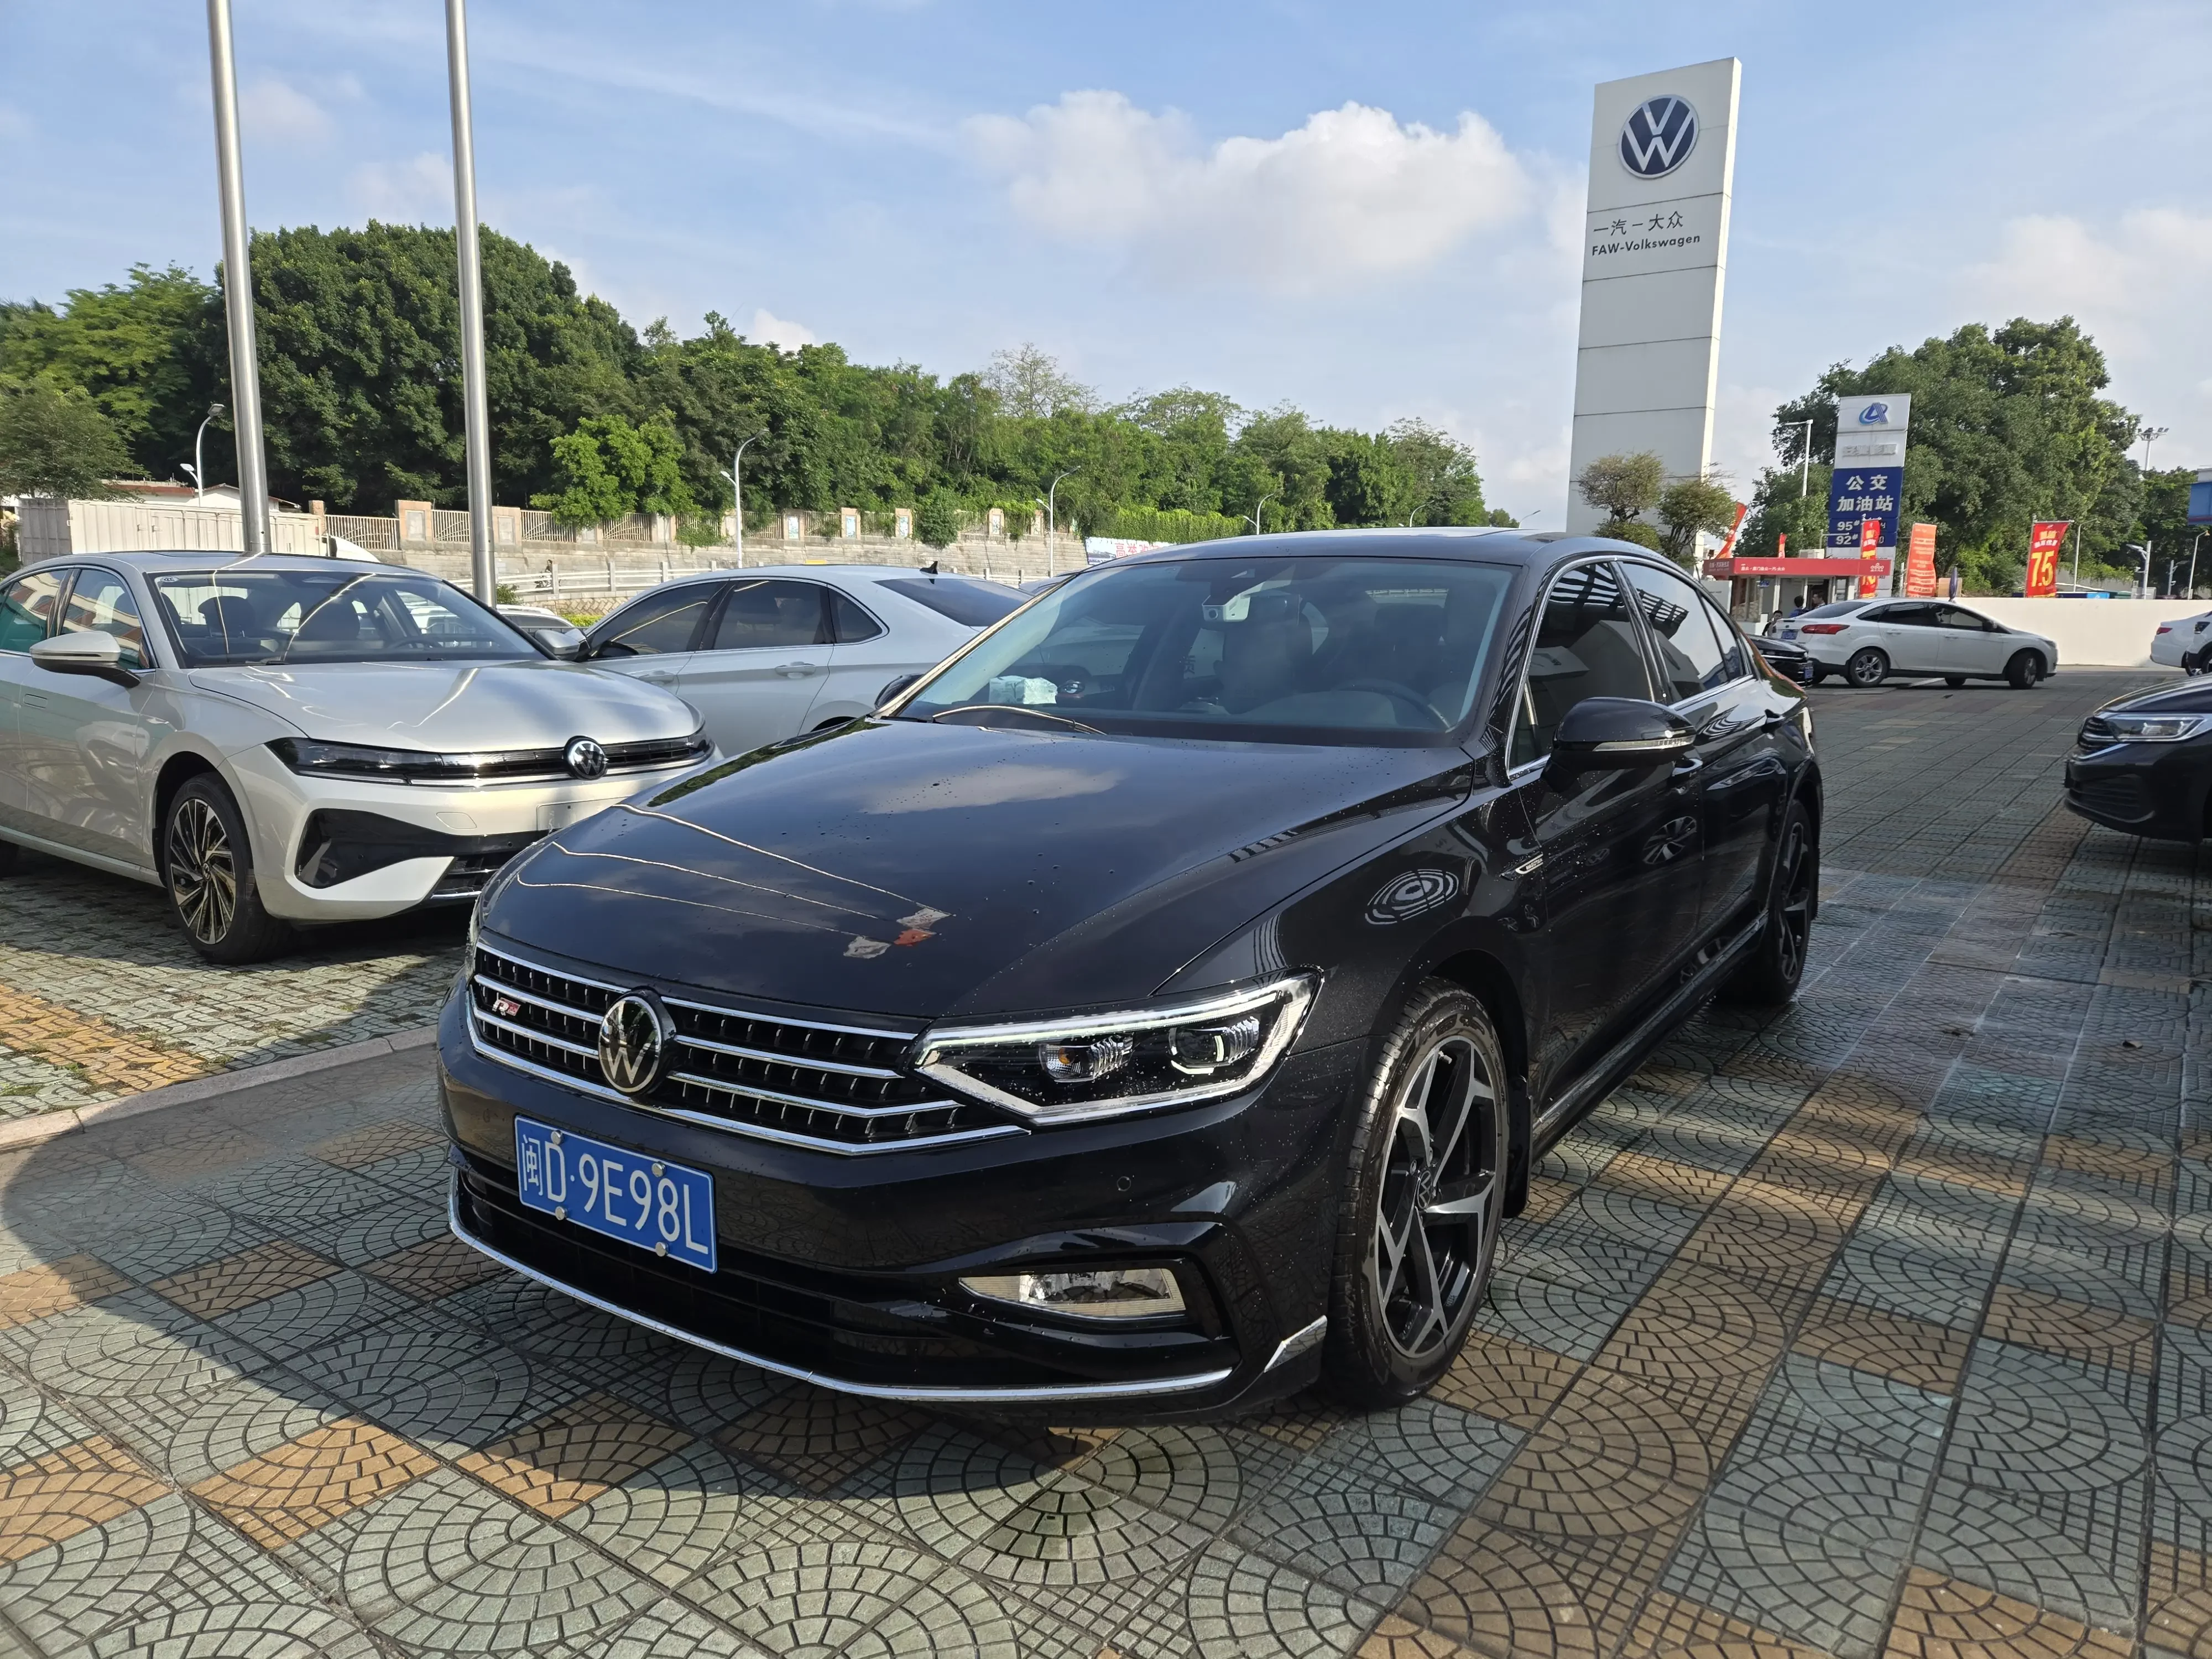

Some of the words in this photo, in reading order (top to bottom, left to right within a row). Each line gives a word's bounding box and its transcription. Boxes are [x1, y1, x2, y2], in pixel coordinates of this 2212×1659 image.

[1592, 235, 1700, 256] FAW-Volkswagen
[1846, 474, 1888, 491] 公交
[1836, 495, 1893, 512] 加油站
[1837, 520, 1860, 531] 95#
[1835, 533, 1859, 545] 92#
[2031, 551, 2054, 587] 7.5
